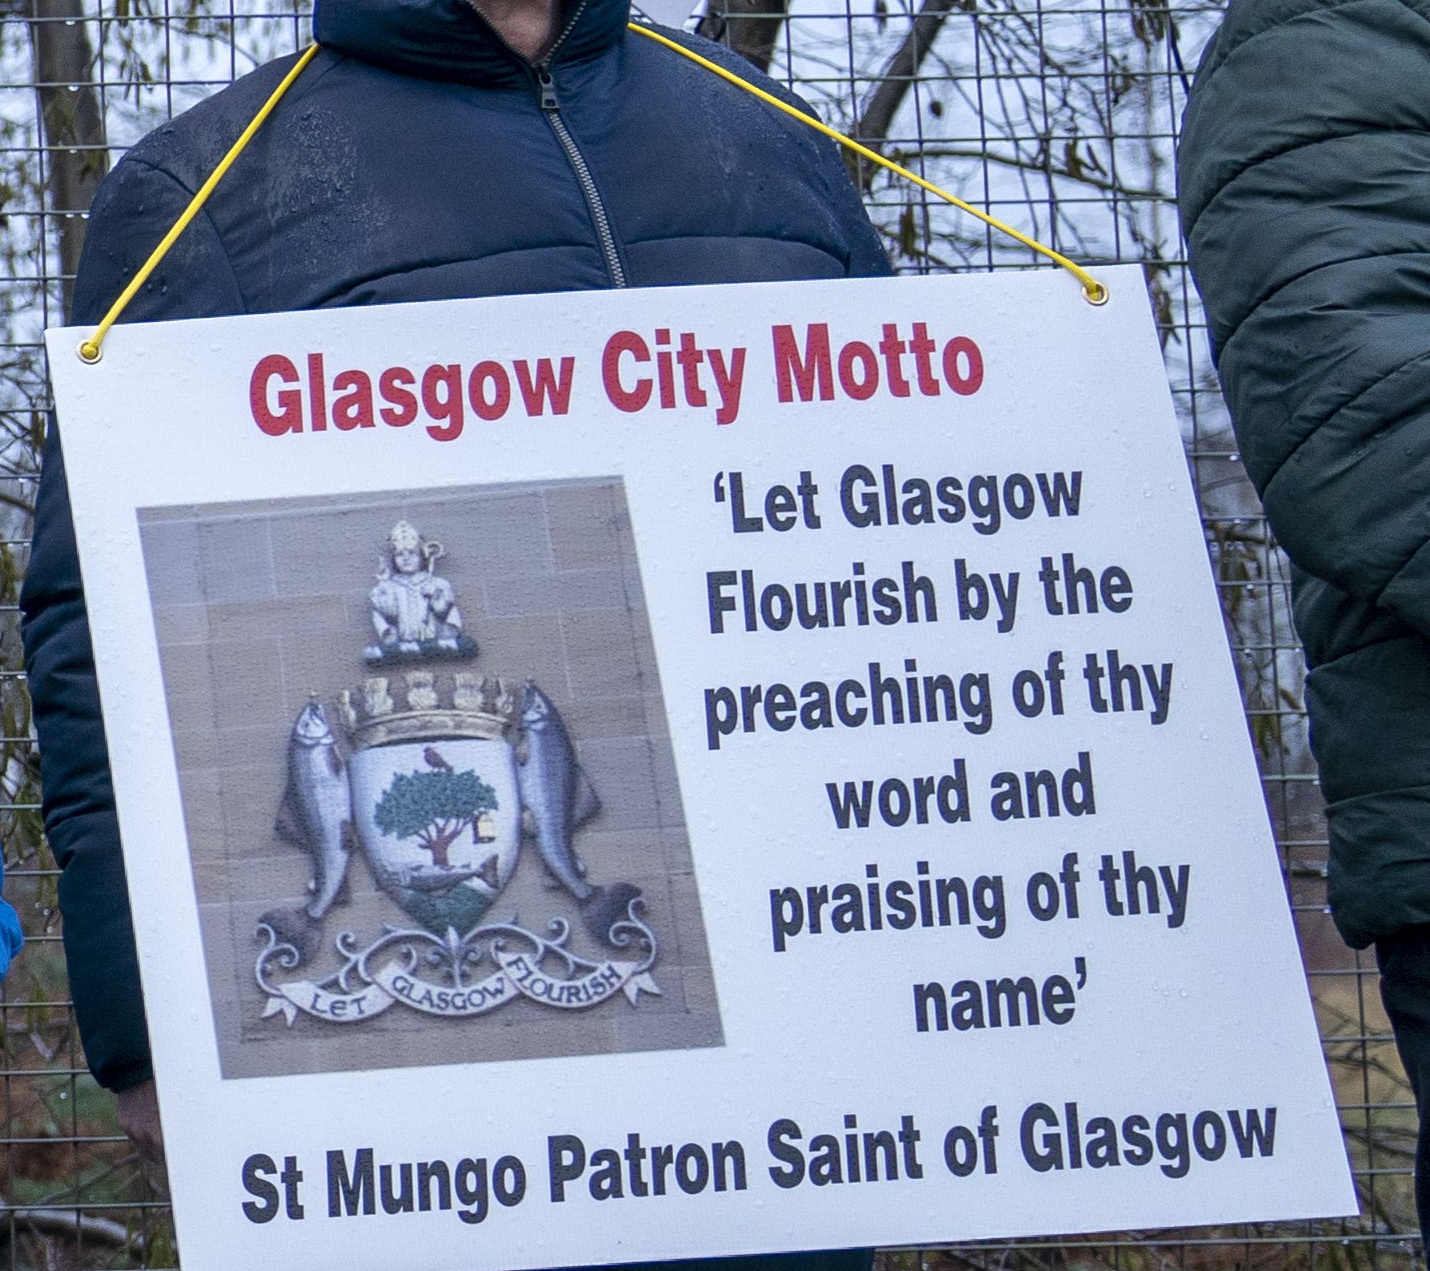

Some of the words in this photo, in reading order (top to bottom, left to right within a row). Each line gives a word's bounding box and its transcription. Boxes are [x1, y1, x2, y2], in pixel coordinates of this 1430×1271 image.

[249, 353, 575, 442] Glasgow
[600, 329, 748, 427] City
[773, 322, 984, 405] Motto
[841, 463, 1085, 535] Glasgow
[706, 558, 939, 635] Flourish
[955, 559, 1020, 628] by
[1038, 551, 1135, 617] the
[704, 659, 995, 751] preaching
[1012, 652, 1067, 720] of
[1083, 649, 1175, 729] thy
[826, 761, 970, 832] word
[990, 751, 1096, 821] and
[767, 860, 1008, 953] praising
[1025, 857, 1082, 925] of
[1098, 851, 1193, 930] thy
[390, 975, 506, 1011] GLASGOW
[508, 955, 622, 1004] FLOURISH
[241, 1152, 305, 1224] St
[326, 1148, 528, 1224] Mungo
[548, 1128, 748, 1205] Patron
[767, 1112, 923, 1186] Saint
[941, 1106, 1000, 1177] of
[1019, 1100, 1279, 1177] Glasgow
